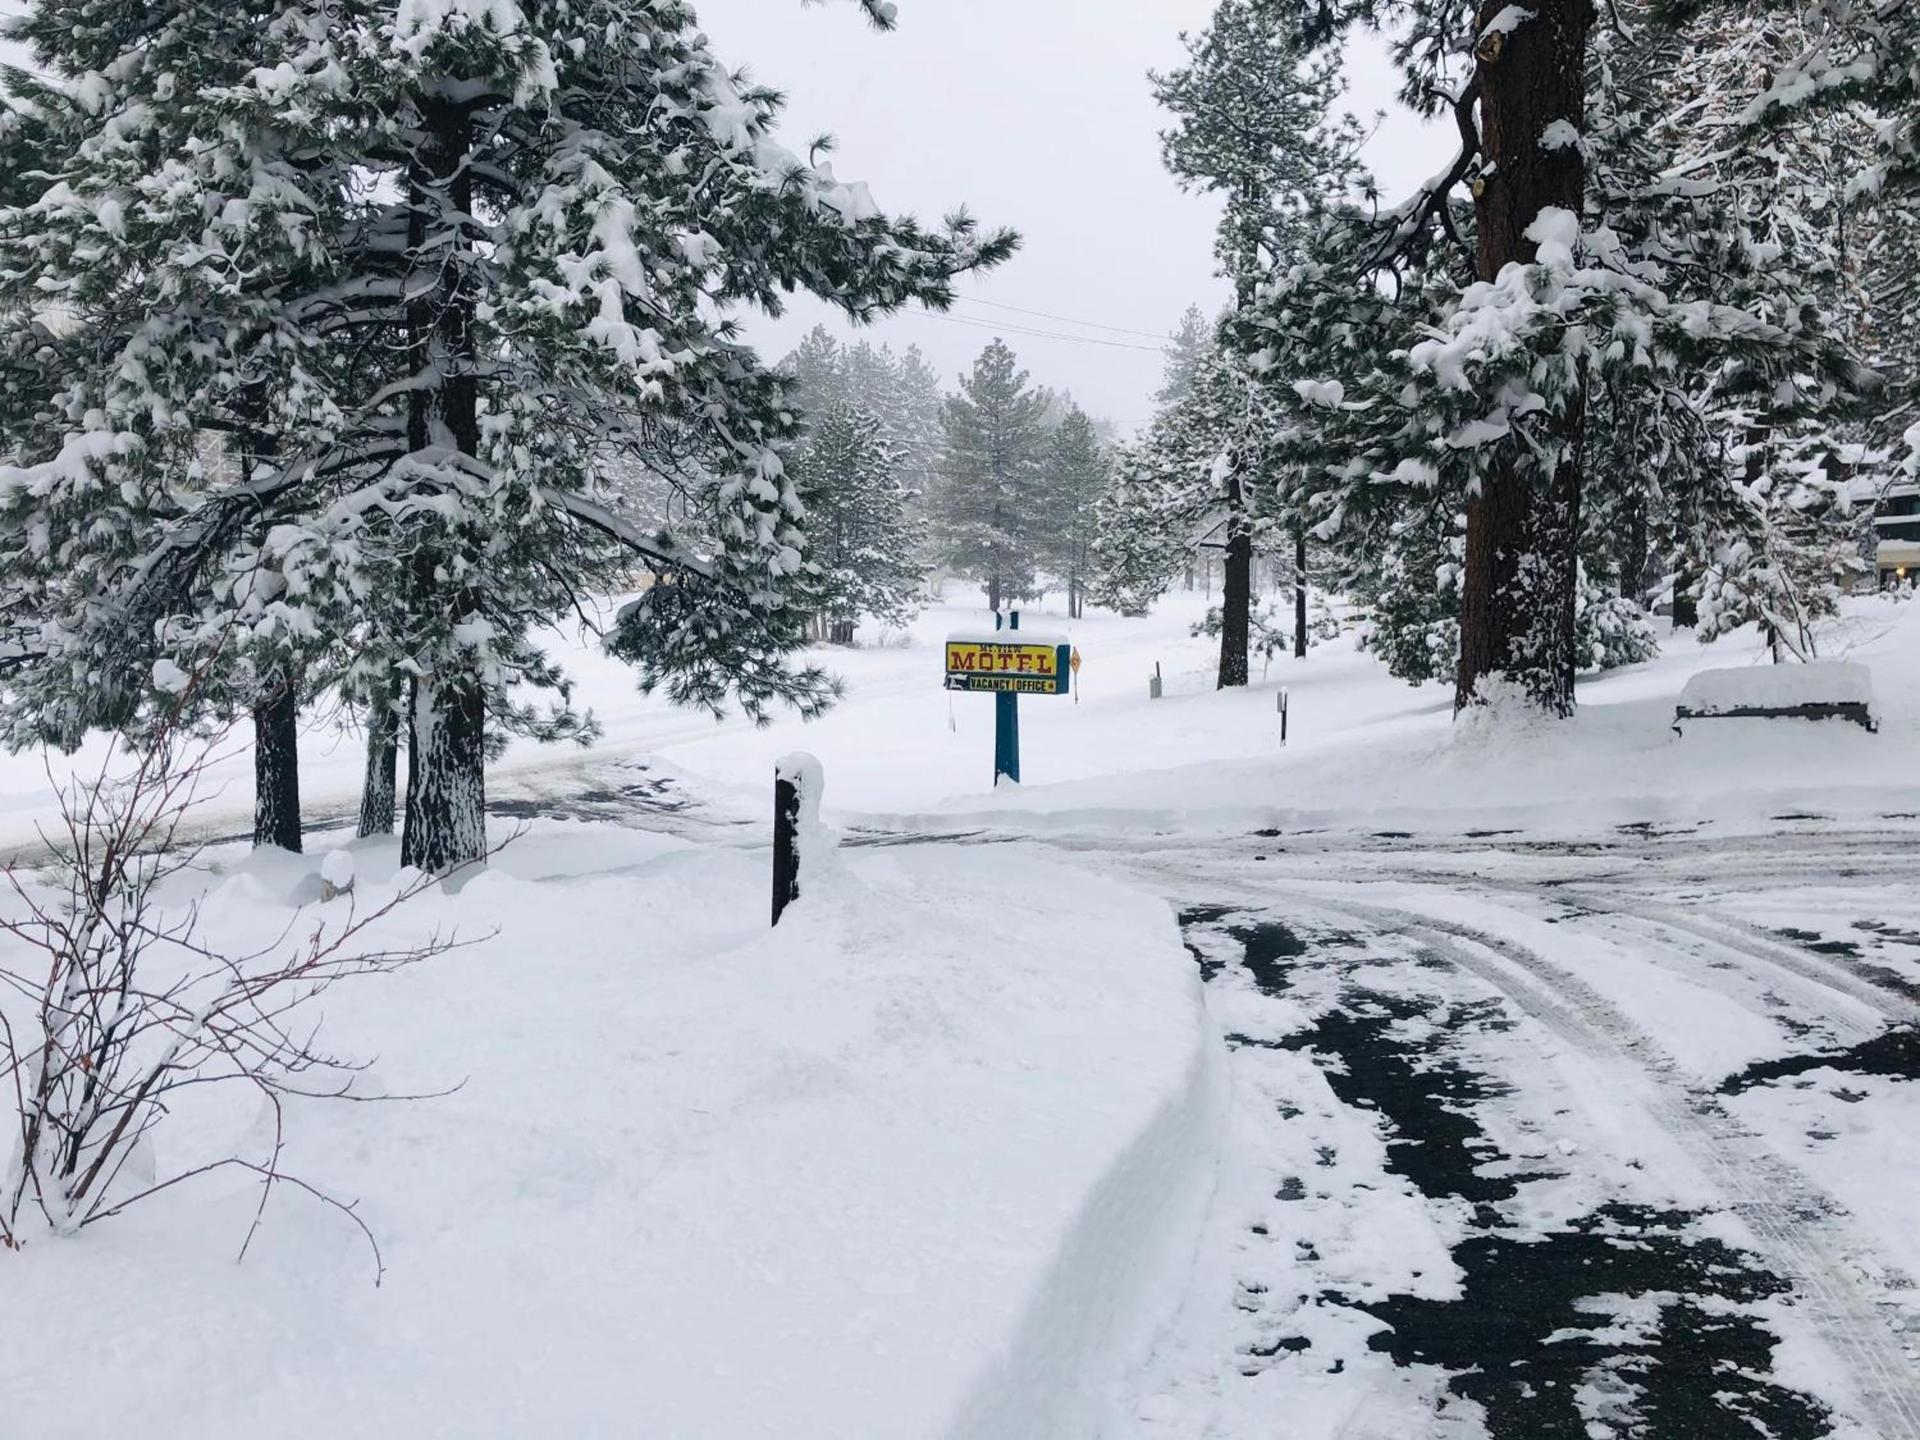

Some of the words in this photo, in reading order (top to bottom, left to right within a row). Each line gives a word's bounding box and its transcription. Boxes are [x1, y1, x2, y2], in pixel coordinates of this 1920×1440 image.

[950, 651, 1052, 674] MOTEL
[971, 678, 1010, 690] VACANCY
[1016, 680, 1047, 692] OFFICE
